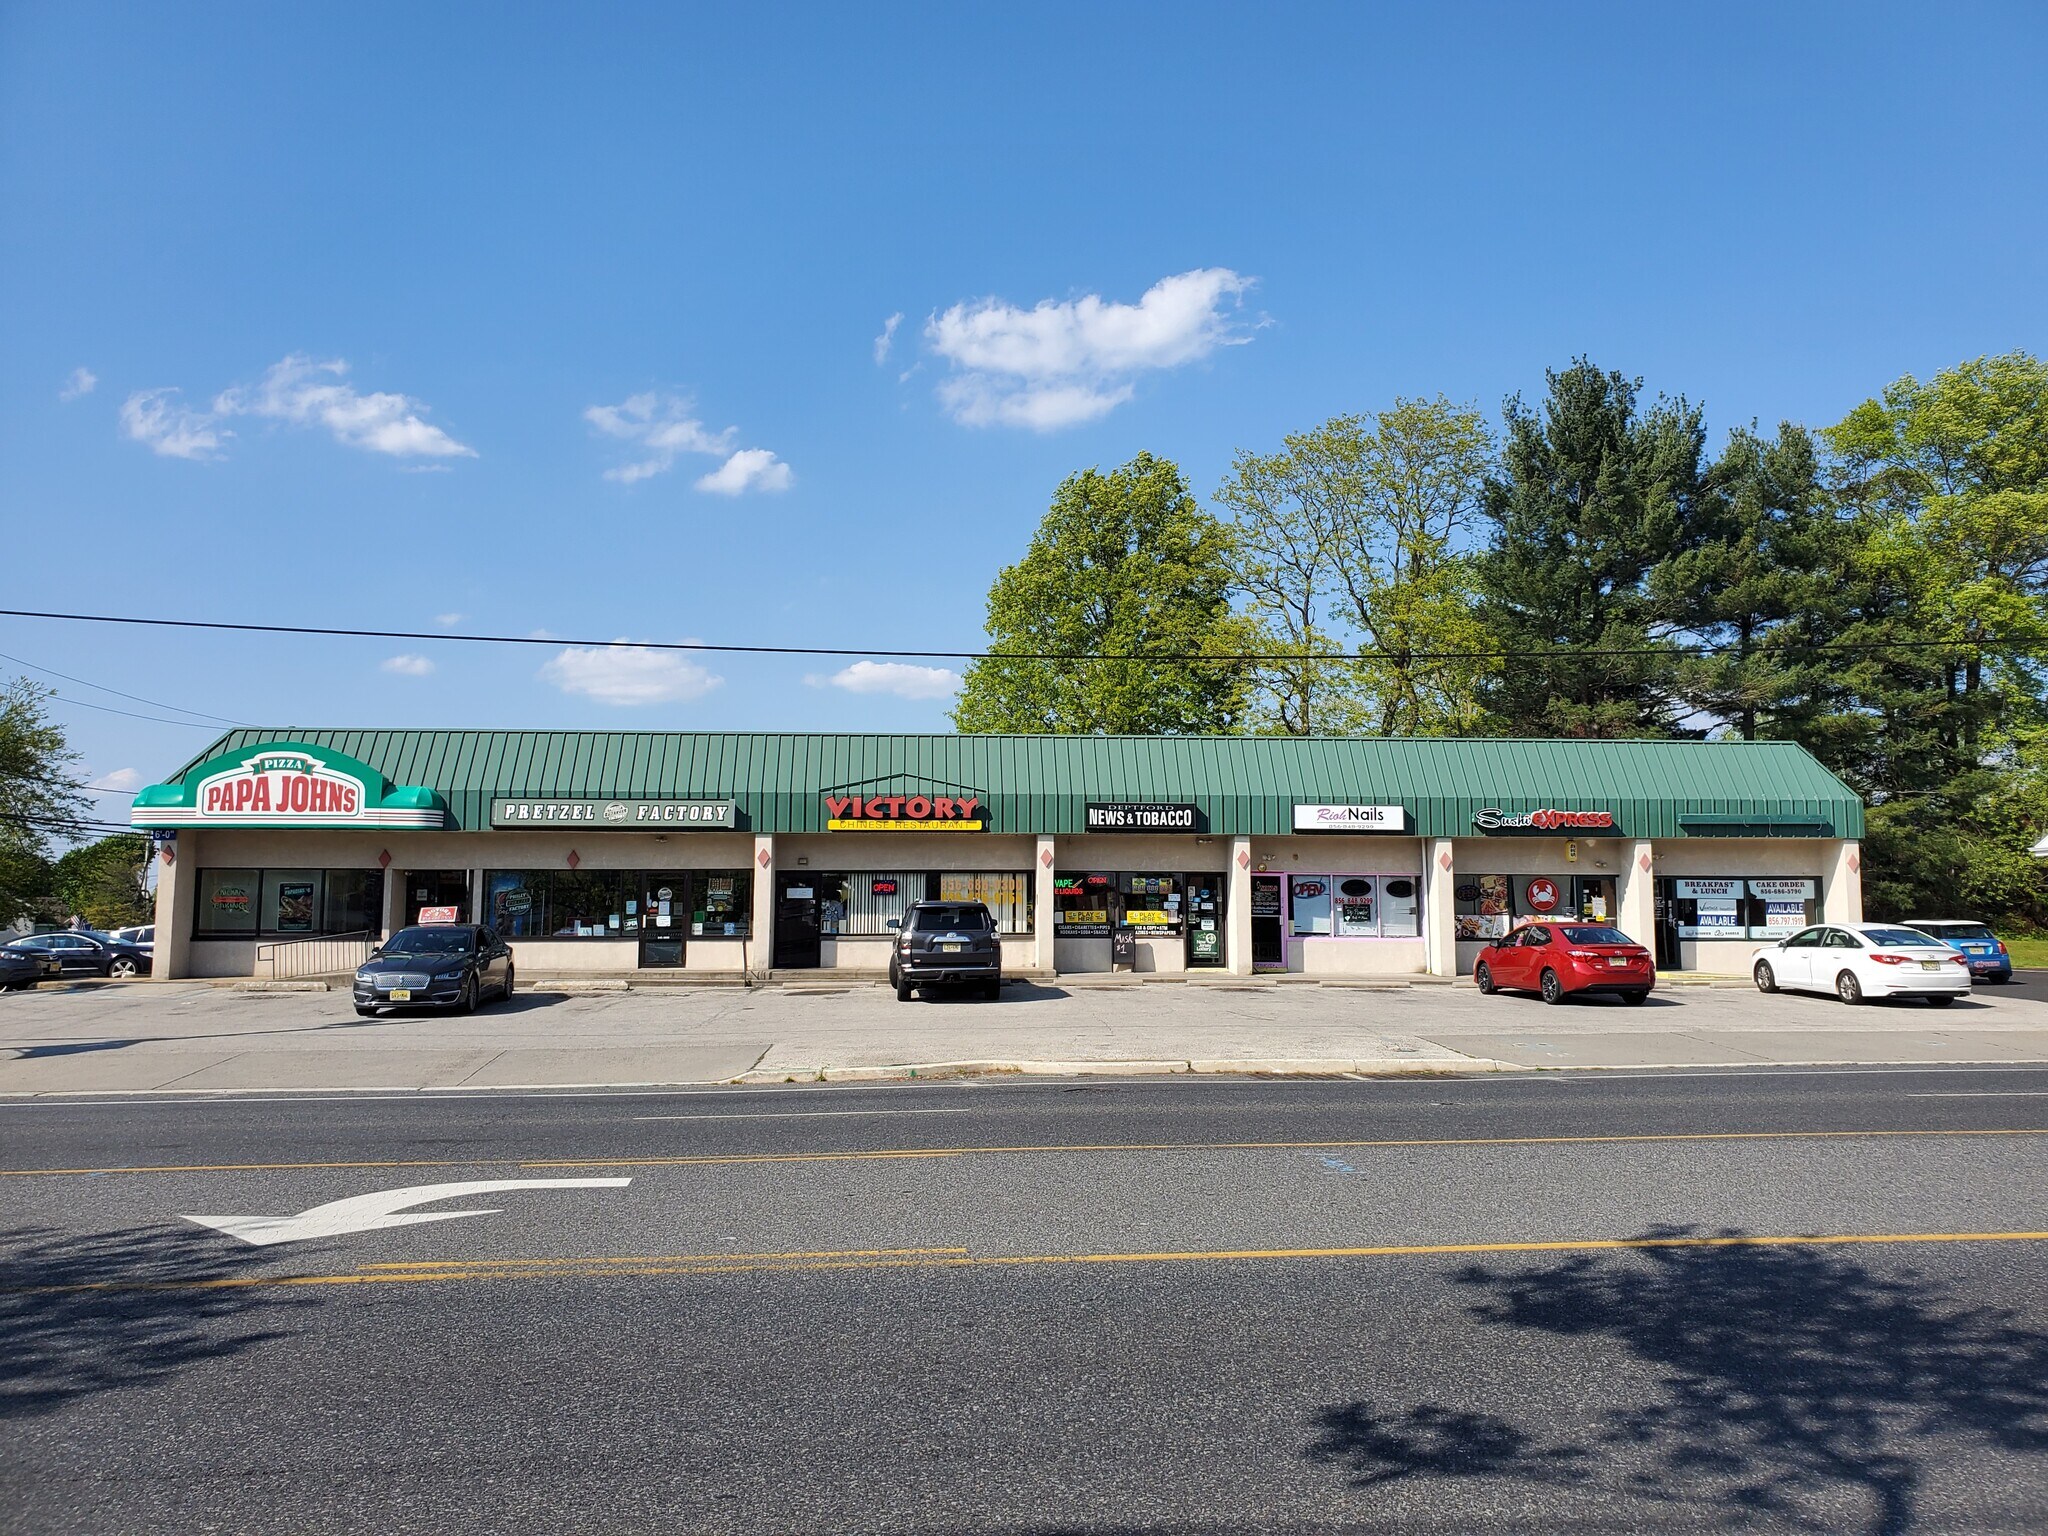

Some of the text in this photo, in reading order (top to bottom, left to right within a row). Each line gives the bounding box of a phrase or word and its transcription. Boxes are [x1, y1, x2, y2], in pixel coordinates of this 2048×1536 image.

[264, 758, 303, 769] PIZZA
[207, 776, 356, 813] PAPA JOHN'S
[825, 795, 978, 819] VICTORY
[504, 804, 596, 820] PRETZEL
[636, 804, 728, 822] FACTORY
[1089, 808, 1192, 826] NEWS & TOBACCO
[1348, 807, 1384, 821] Nails
[1476, 808, 1532, 828] Sushi
[839, 820, 971, 829] CHINESE RESTAURANT
[873, 883, 895, 892] OPEN
[1054, 879, 1074, 888] VAPE
[1294, 883, 1324, 896] OPEN
[1767, 903, 1804, 914] AVAILABLE
[1700, 916, 1736, 926] AVAILABLE
[1768, 916, 1804, 926] 856.797.1919
[1116, 943, 1128, 954] $1
